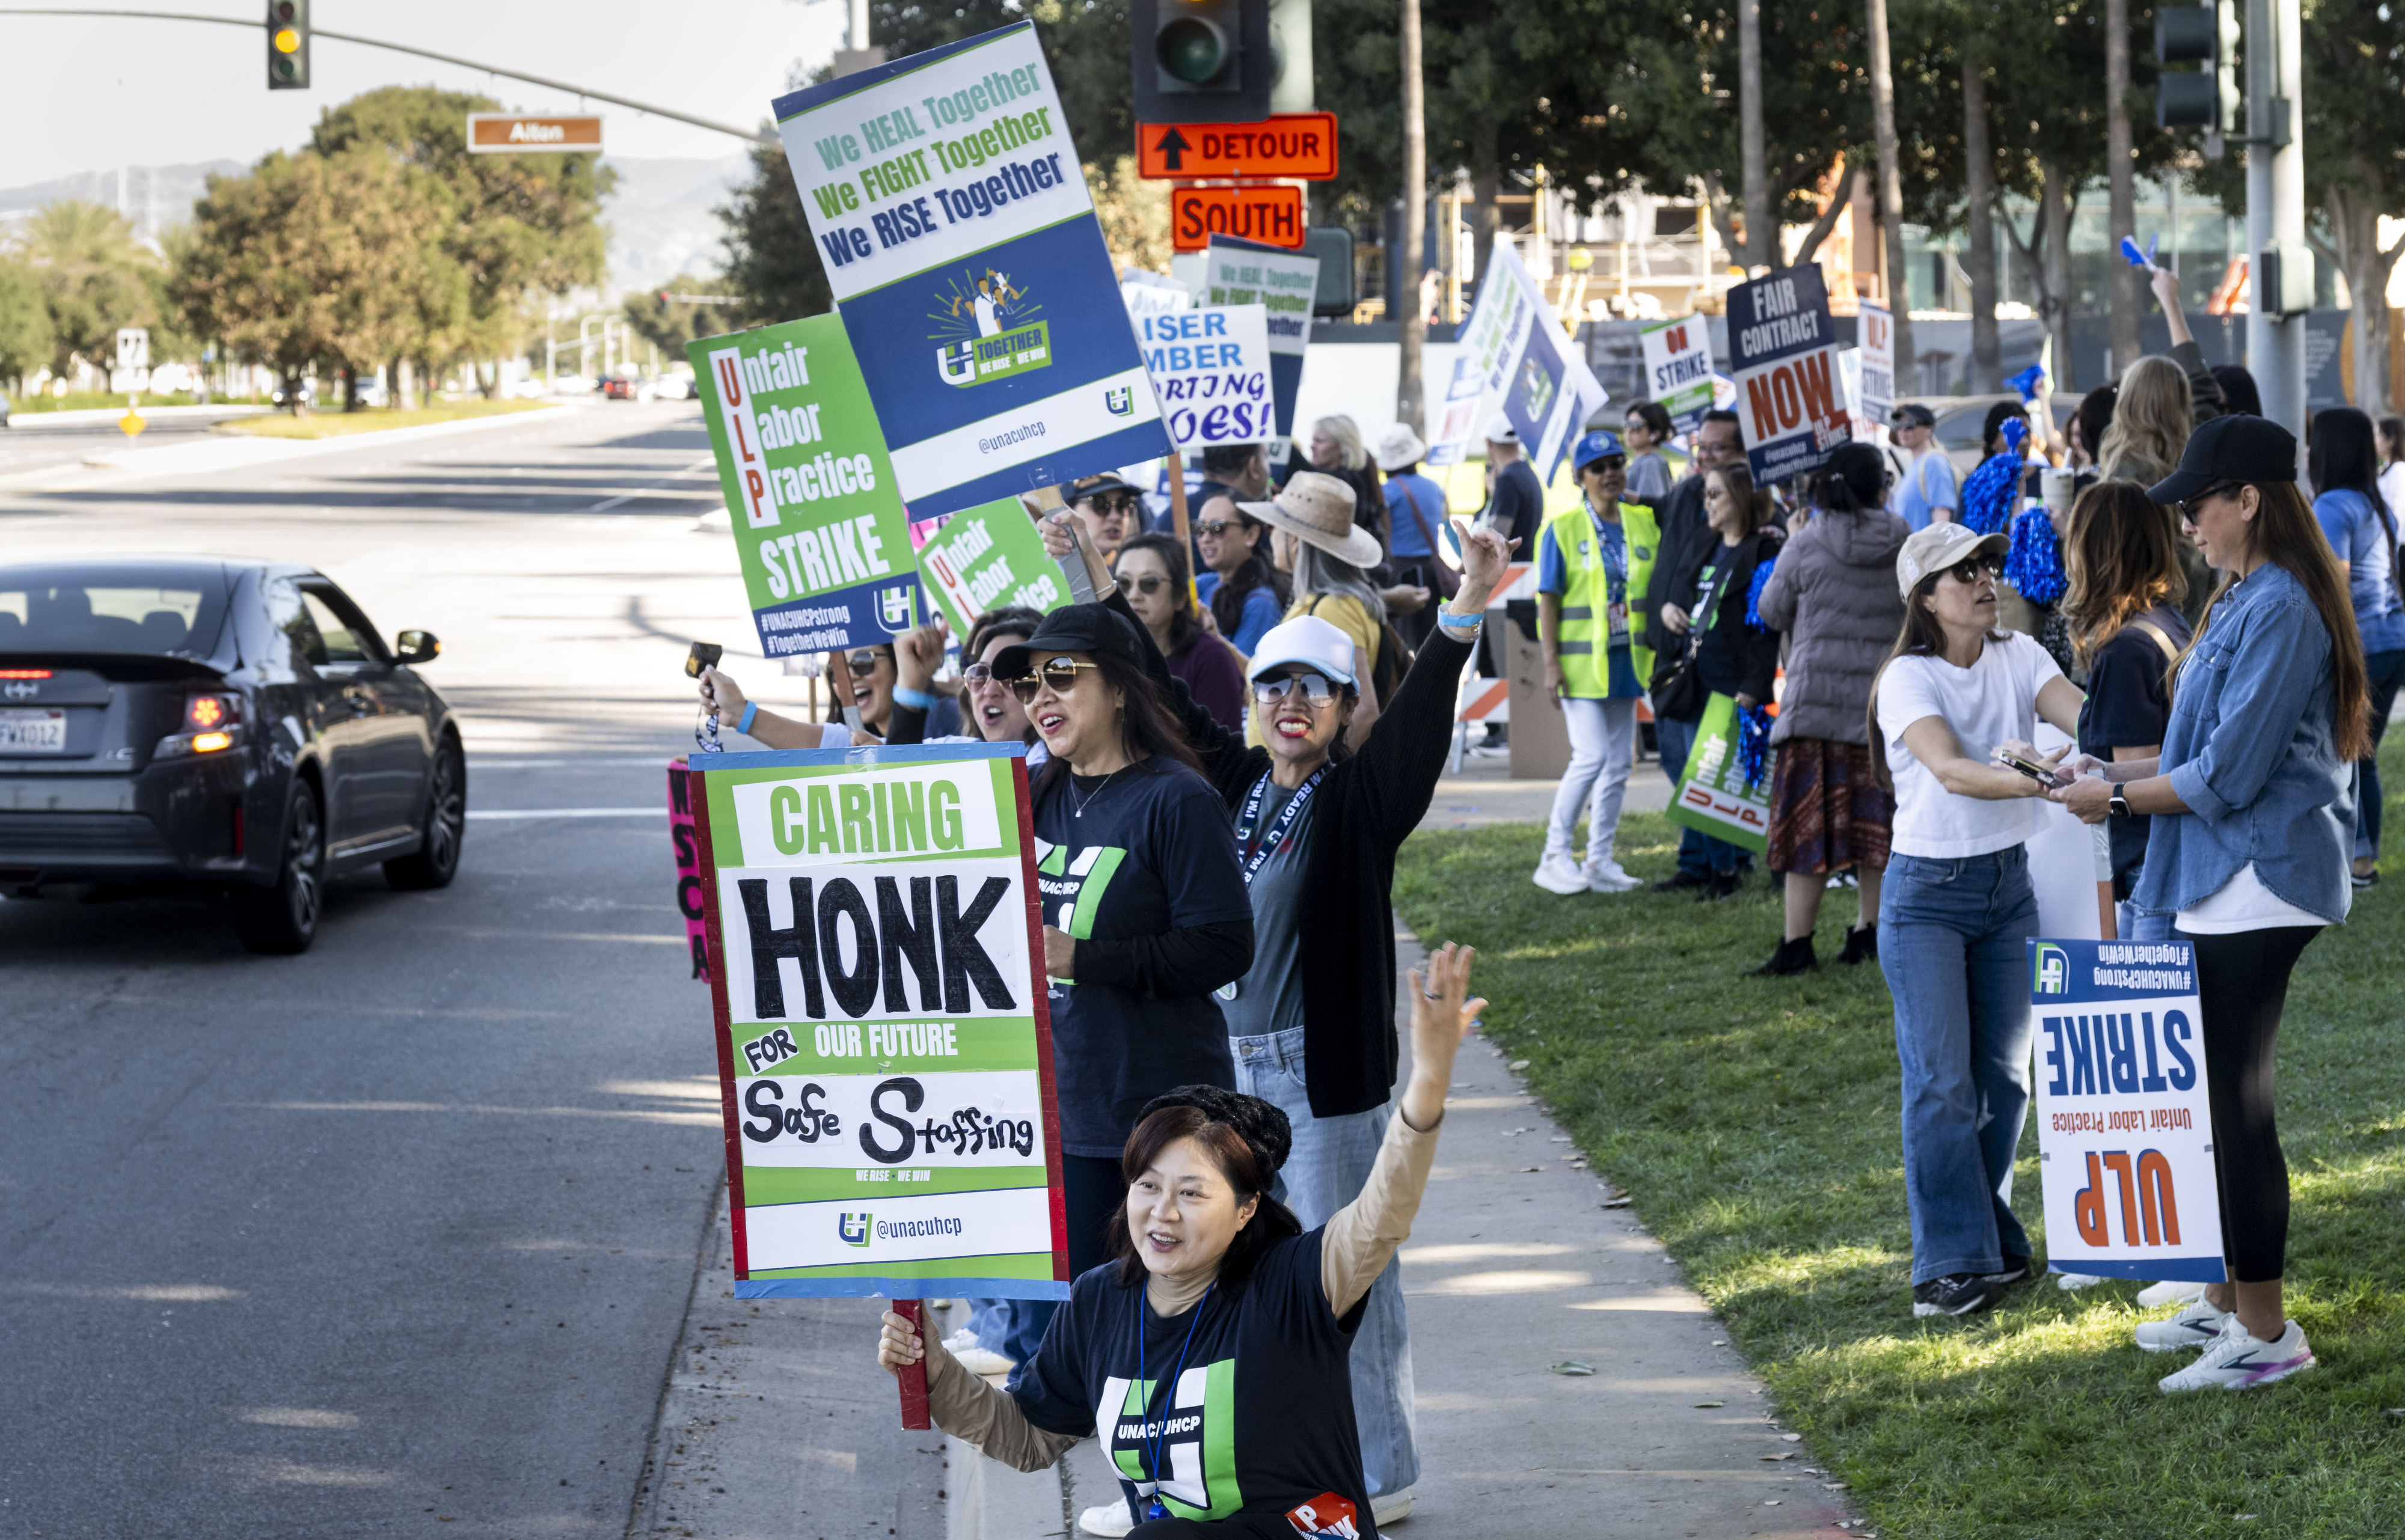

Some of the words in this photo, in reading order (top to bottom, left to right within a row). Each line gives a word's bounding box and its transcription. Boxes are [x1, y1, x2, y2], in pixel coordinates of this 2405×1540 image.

[814, 135, 860, 171] We
[860, 106, 926, 153] HEAL
[922, 62, 1041, 129] Together
[812, 182, 860, 219] We
[859, 148, 931, 202] FIGHT
[931, 106, 1053, 174] Together
[1203, 132, 1319, 159] DETOUR
[821, 228, 872, 267] We
[871, 197, 938, 248] RISE
[934, 152, 1065, 224] Together
[1182, 198, 1293, 237] SOUTH
[1752, 277, 1798, 322] FAIR
[977, 328, 1043, 360] TOGETHER
[1140, 313, 1227, 341] ISER
[1741, 309, 1819, 358] CONTRACT
[718, 341, 810, 407] Unfair
[979, 361, 993, 375] WE
[991, 356, 1011, 371] RISE
[1016, 351, 1029, 365] WE
[1029, 346, 1046, 361] WIN
[1656, 351, 1708, 390] STRIKE
[1156, 372, 1265, 400] RTING
[1746, 350, 1836, 442] NOW
[733, 403, 823, 463] Labor
[979, 421, 1046, 454] @unacuhcp
[745, 451, 875, 518] Practice
[759, 513, 891, 599] STRIKE
[761, 605, 851, 632] #UNACUHCPstrong
[767, 627, 850, 655] #TogetherWeWin
[770, 780, 964, 856] CARING
[1280, 783, 1314, 827] READY
[1249, 850, 1267, 871] I'M
[737, 875, 1017, 1019] HONK
[2098, 944, 2189, 966] #TogetherWeWin
[2093, 967, 2192, 991] #UNACUHCPstrong
[744, 1029, 798, 1072] FOR
[815, 1024, 862, 1057] OUR
[869, 1022, 958, 1057] FUTURE
[2042, 1009, 2197, 1096] STRIKE
[743, 1080, 841, 1143] Safe
[859, 1077, 1034, 1164] Staffing
[2052, 1113, 2103, 1135] Practice
[2108, 1110, 2145, 1132] Labor
[2150, 1107, 2192, 1130] Unfair
[856, 1169, 868, 1181] WE
[869, 1169, 890, 1182] RISE
[897, 1169, 911, 1182] WE
[911, 1169, 931, 1182] WIN
[2074, 1148, 2181, 1247] ULP
[877, 1217, 962, 1239] @unacuhcp
